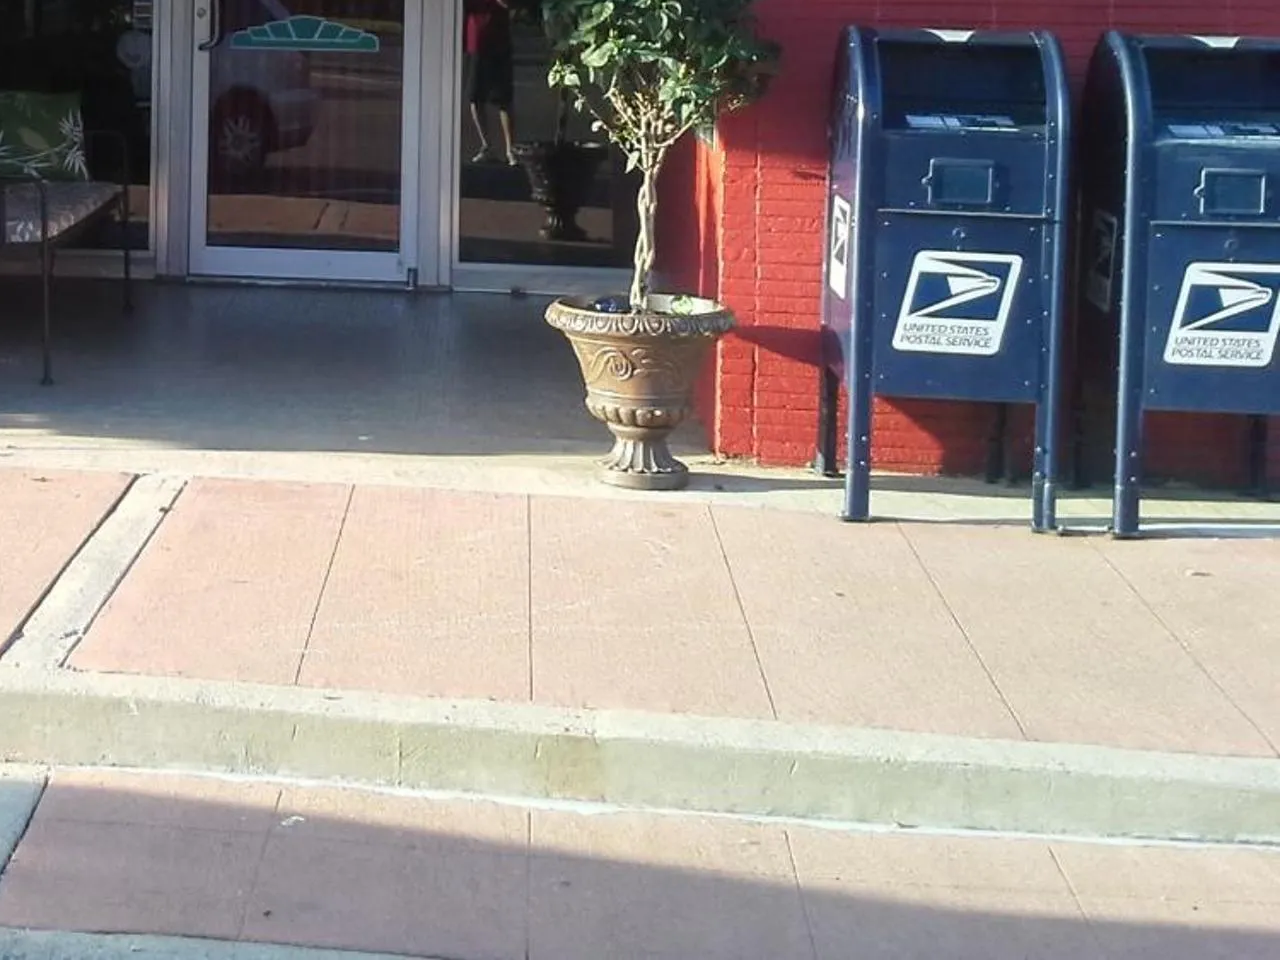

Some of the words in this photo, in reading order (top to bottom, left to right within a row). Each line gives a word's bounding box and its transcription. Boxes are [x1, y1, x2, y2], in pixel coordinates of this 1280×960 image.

[903, 323, 948, 334] UNITED
[949, 324, 989, 336] STATES
[900, 334, 943, 346] POSTAL
[945, 336, 993, 348] SERVICE
[1175, 336, 1220, 347] UNITED
[1221, 338, 1261, 349] STATES
[1171, 347, 1213, 358] POSTAL
[1217, 348, 1265, 360] SERVICE
